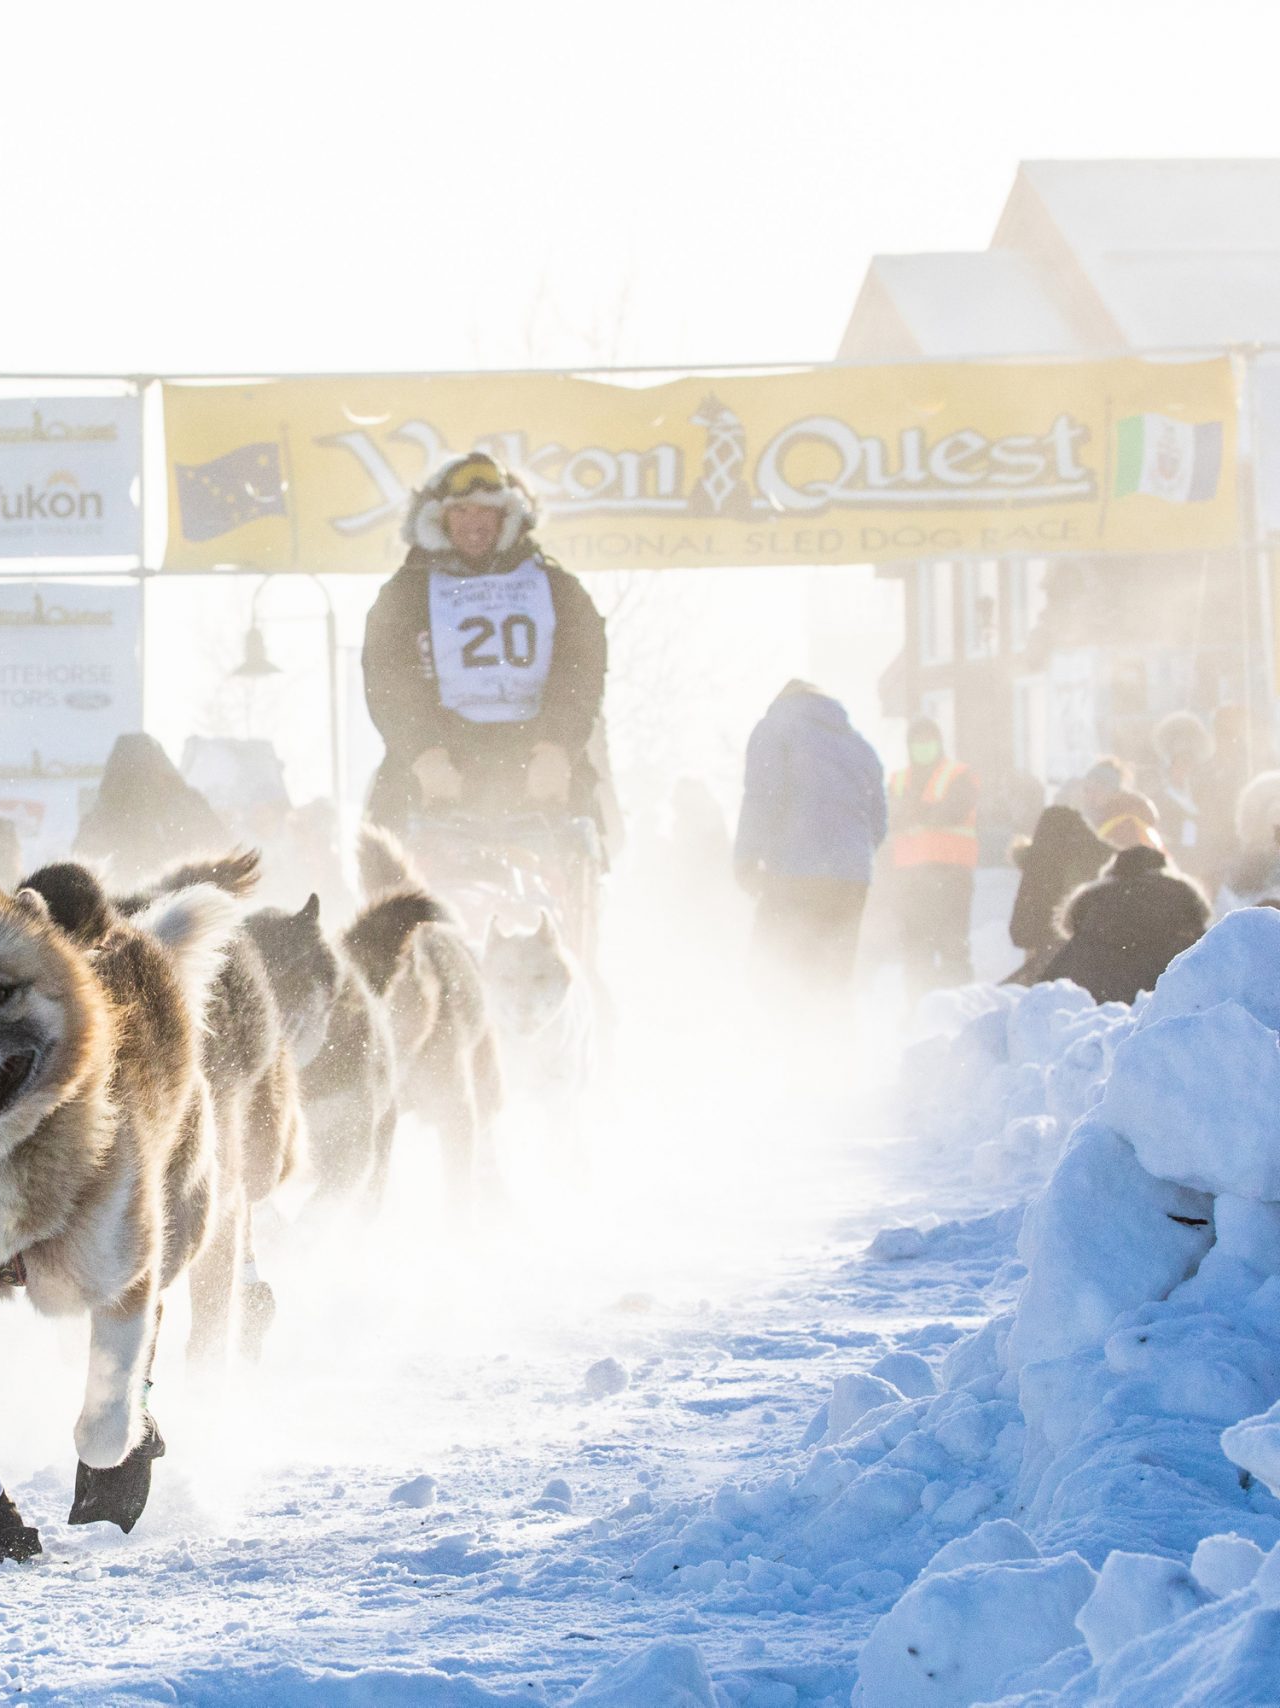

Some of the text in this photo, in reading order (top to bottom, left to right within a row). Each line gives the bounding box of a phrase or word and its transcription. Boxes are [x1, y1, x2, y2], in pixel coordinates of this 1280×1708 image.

[313, 411, 1097, 537] Ykon Quest
[383, 518, 1082, 562] IATIONAL SLED DOG RACE
[458, 613, 537, 669] 20
